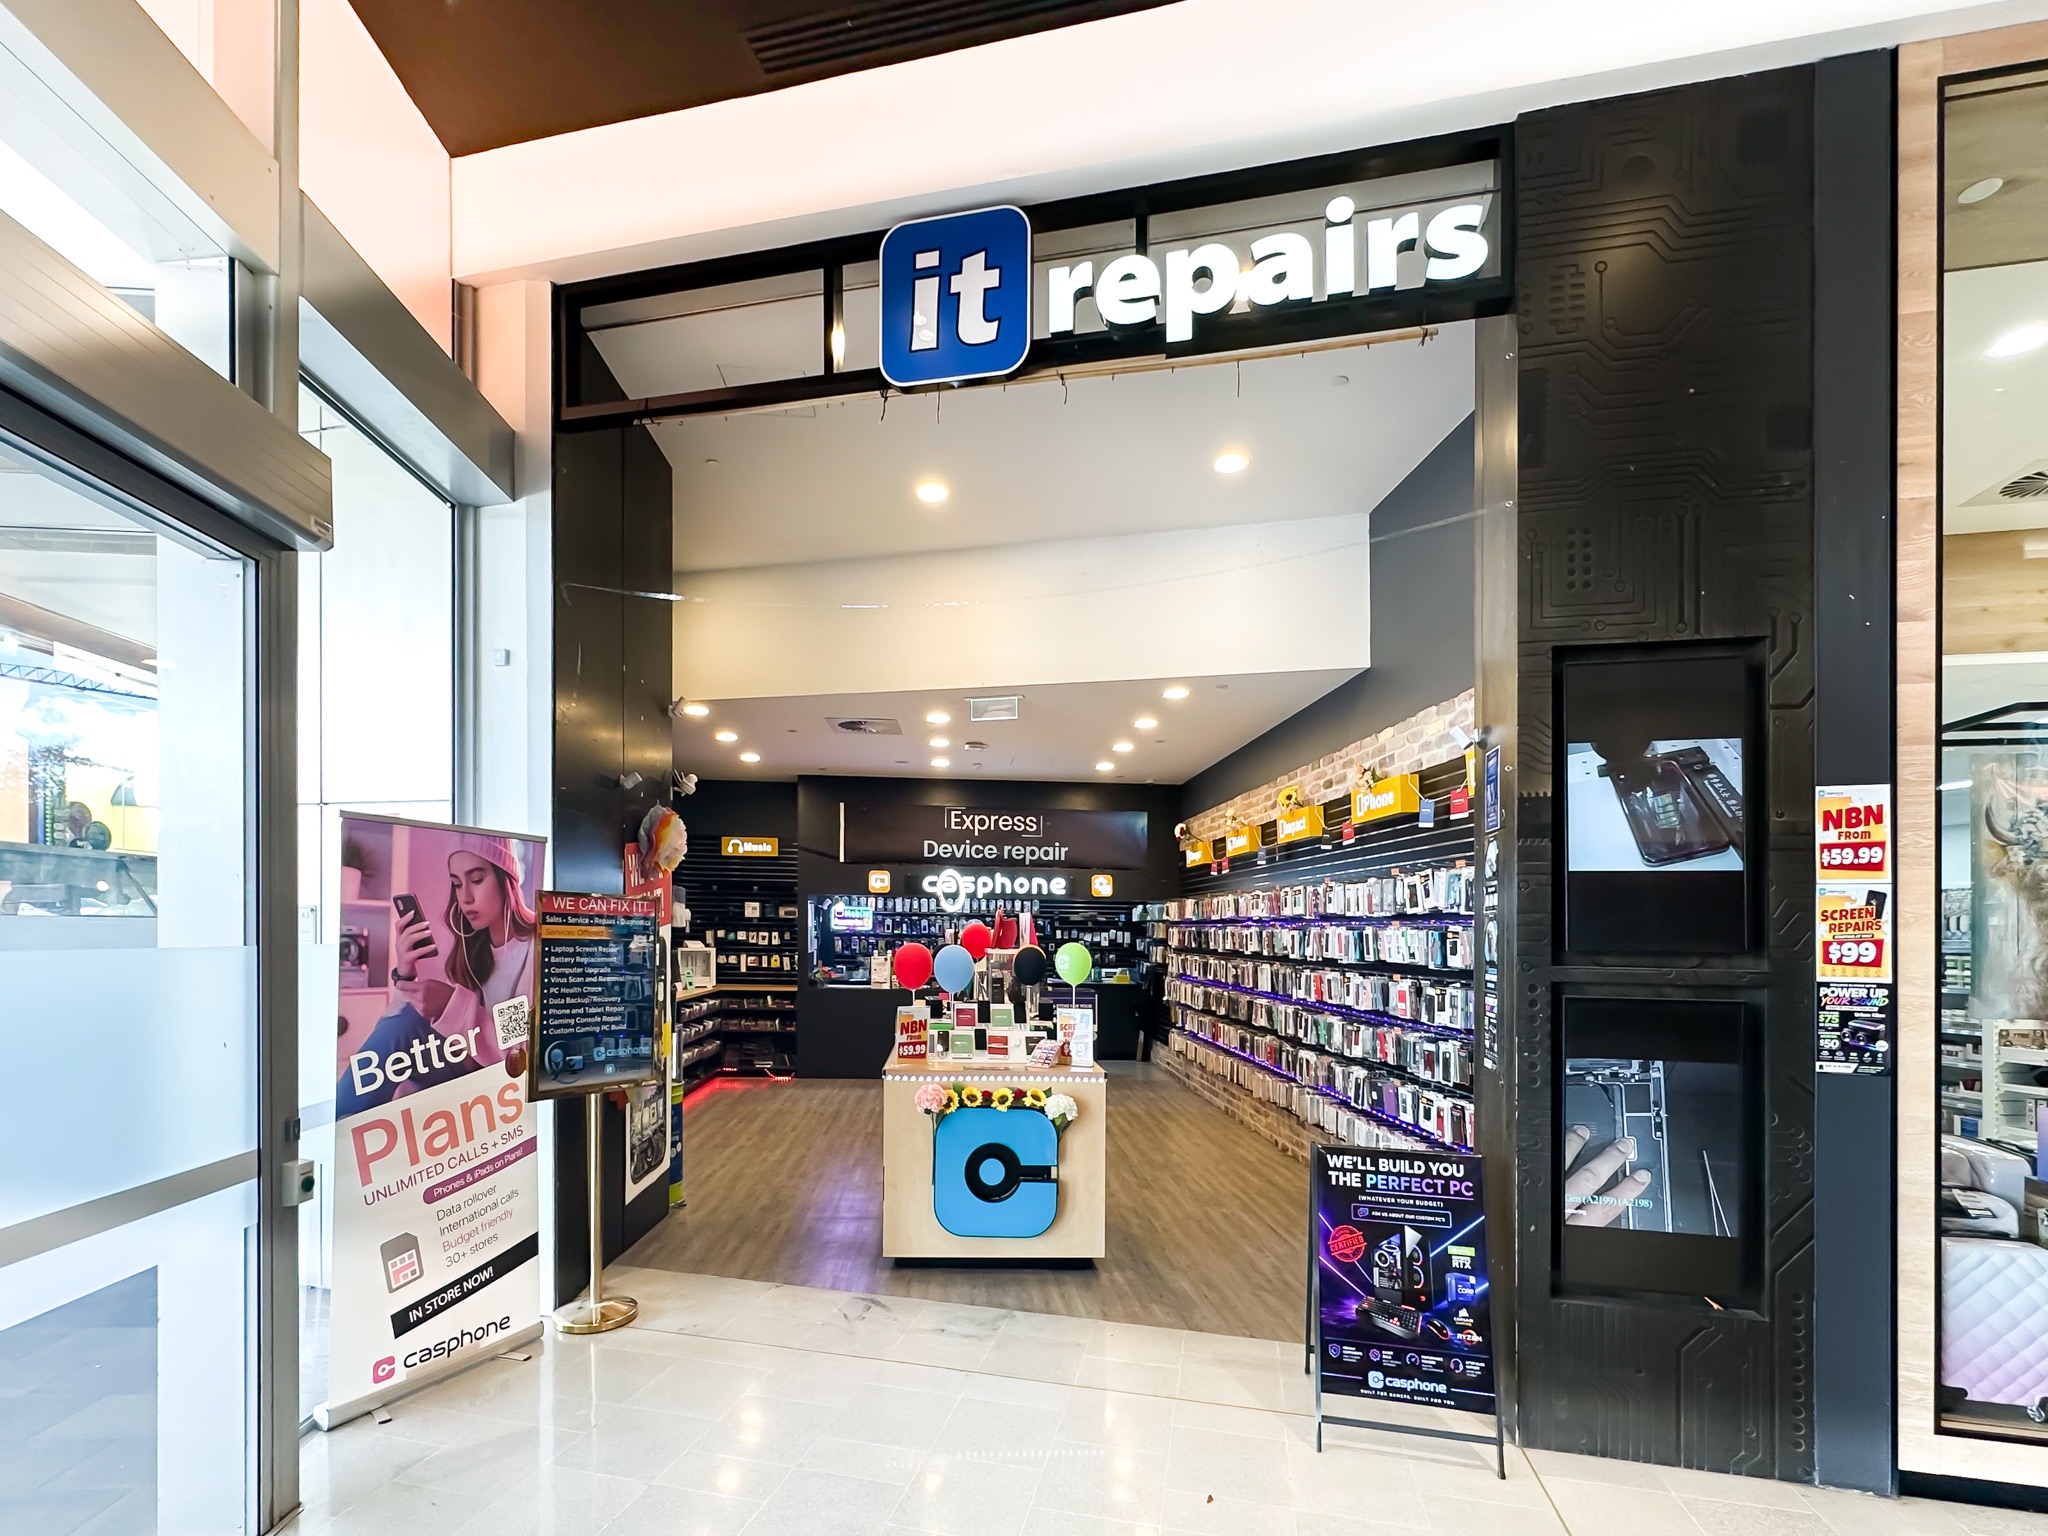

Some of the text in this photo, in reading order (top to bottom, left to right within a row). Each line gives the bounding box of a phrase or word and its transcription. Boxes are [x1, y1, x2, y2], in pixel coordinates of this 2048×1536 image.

[909, 196, 1489, 353] it repairs
[951, 810, 1038, 836] Express
[1822, 804, 1884, 832] NBN
[744, 842, 772, 852] Music
[923, 840, 1068, 865] Device repair
[1822, 846, 1883, 866] $59.99
[922, 872, 1066, 898] casphone
[552, 896, 647, 912] WE CAN FIX IT!
[568, 916, 589, 924] Service
[594, 918, 616, 926] Repairs
[1821, 907, 1874, 922] SCREEN
[546, 928, 576, 936] Services
[1829, 920, 1882, 933] REPAIRS
[551, 946, 574, 954] Laptop
[1828, 942, 1876, 964] $99
[550, 956, 574, 964] Battery
[1820, 987, 1889, 998] POWER UP
[1820, 997, 1889, 1006] YOUR SOUND
[549, 1018, 574, 1026] Gaming
[602, 1015, 622, 1023] Repair
[900, 1019, 927, 1035] NBN
[1819, 1014, 1839, 1023] $75
[576, 1026, 600, 1034] Gaming
[899, 1044, 926, 1056] $59.99
[1819, 1039, 1840, 1049] $50
[350, 1026, 480, 1096] Better
[351, 1082, 523, 1188] Plans
[364, 1162, 444, 1206] UNLIMITED
[448, 1142, 488, 1170] CALLS
[501, 1125, 524, 1145] SMS
[433, 1149, 524, 1197] Phones & iPads on Plans!
[1326, 1154, 1464, 1177] WE'LL BUILD YOU
[1328, 1171, 1474, 1196] THE PERFECT PC
[436, 1185, 497, 1221] Data rollover
[1358, 1195, 1395, 1204] (WHATEVER
[1416, 1200, 1443, 1208] BUDGET)
[1582, 1195, 1616, 1206] (A2199)
[1618, 1198, 1653, 1209] (A2198)
[439, 1188, 519, 1236] International calls
[442, 1208, 513, 1252] Budget friendly
[446, 1233, 498, 1268] 30+ stores
[1330, 1235, 1364, 1252] CERTIFIED
[1452, 1260, 1472, 1269] RTX
[408, 1266, 494, 1322] IN STORE NOW!
[404, 1316, 510, 1369] casphone
[1457, 1333, 1482, 1342] RYZEN
[1385, 1377, 1447, 1394] casphone
